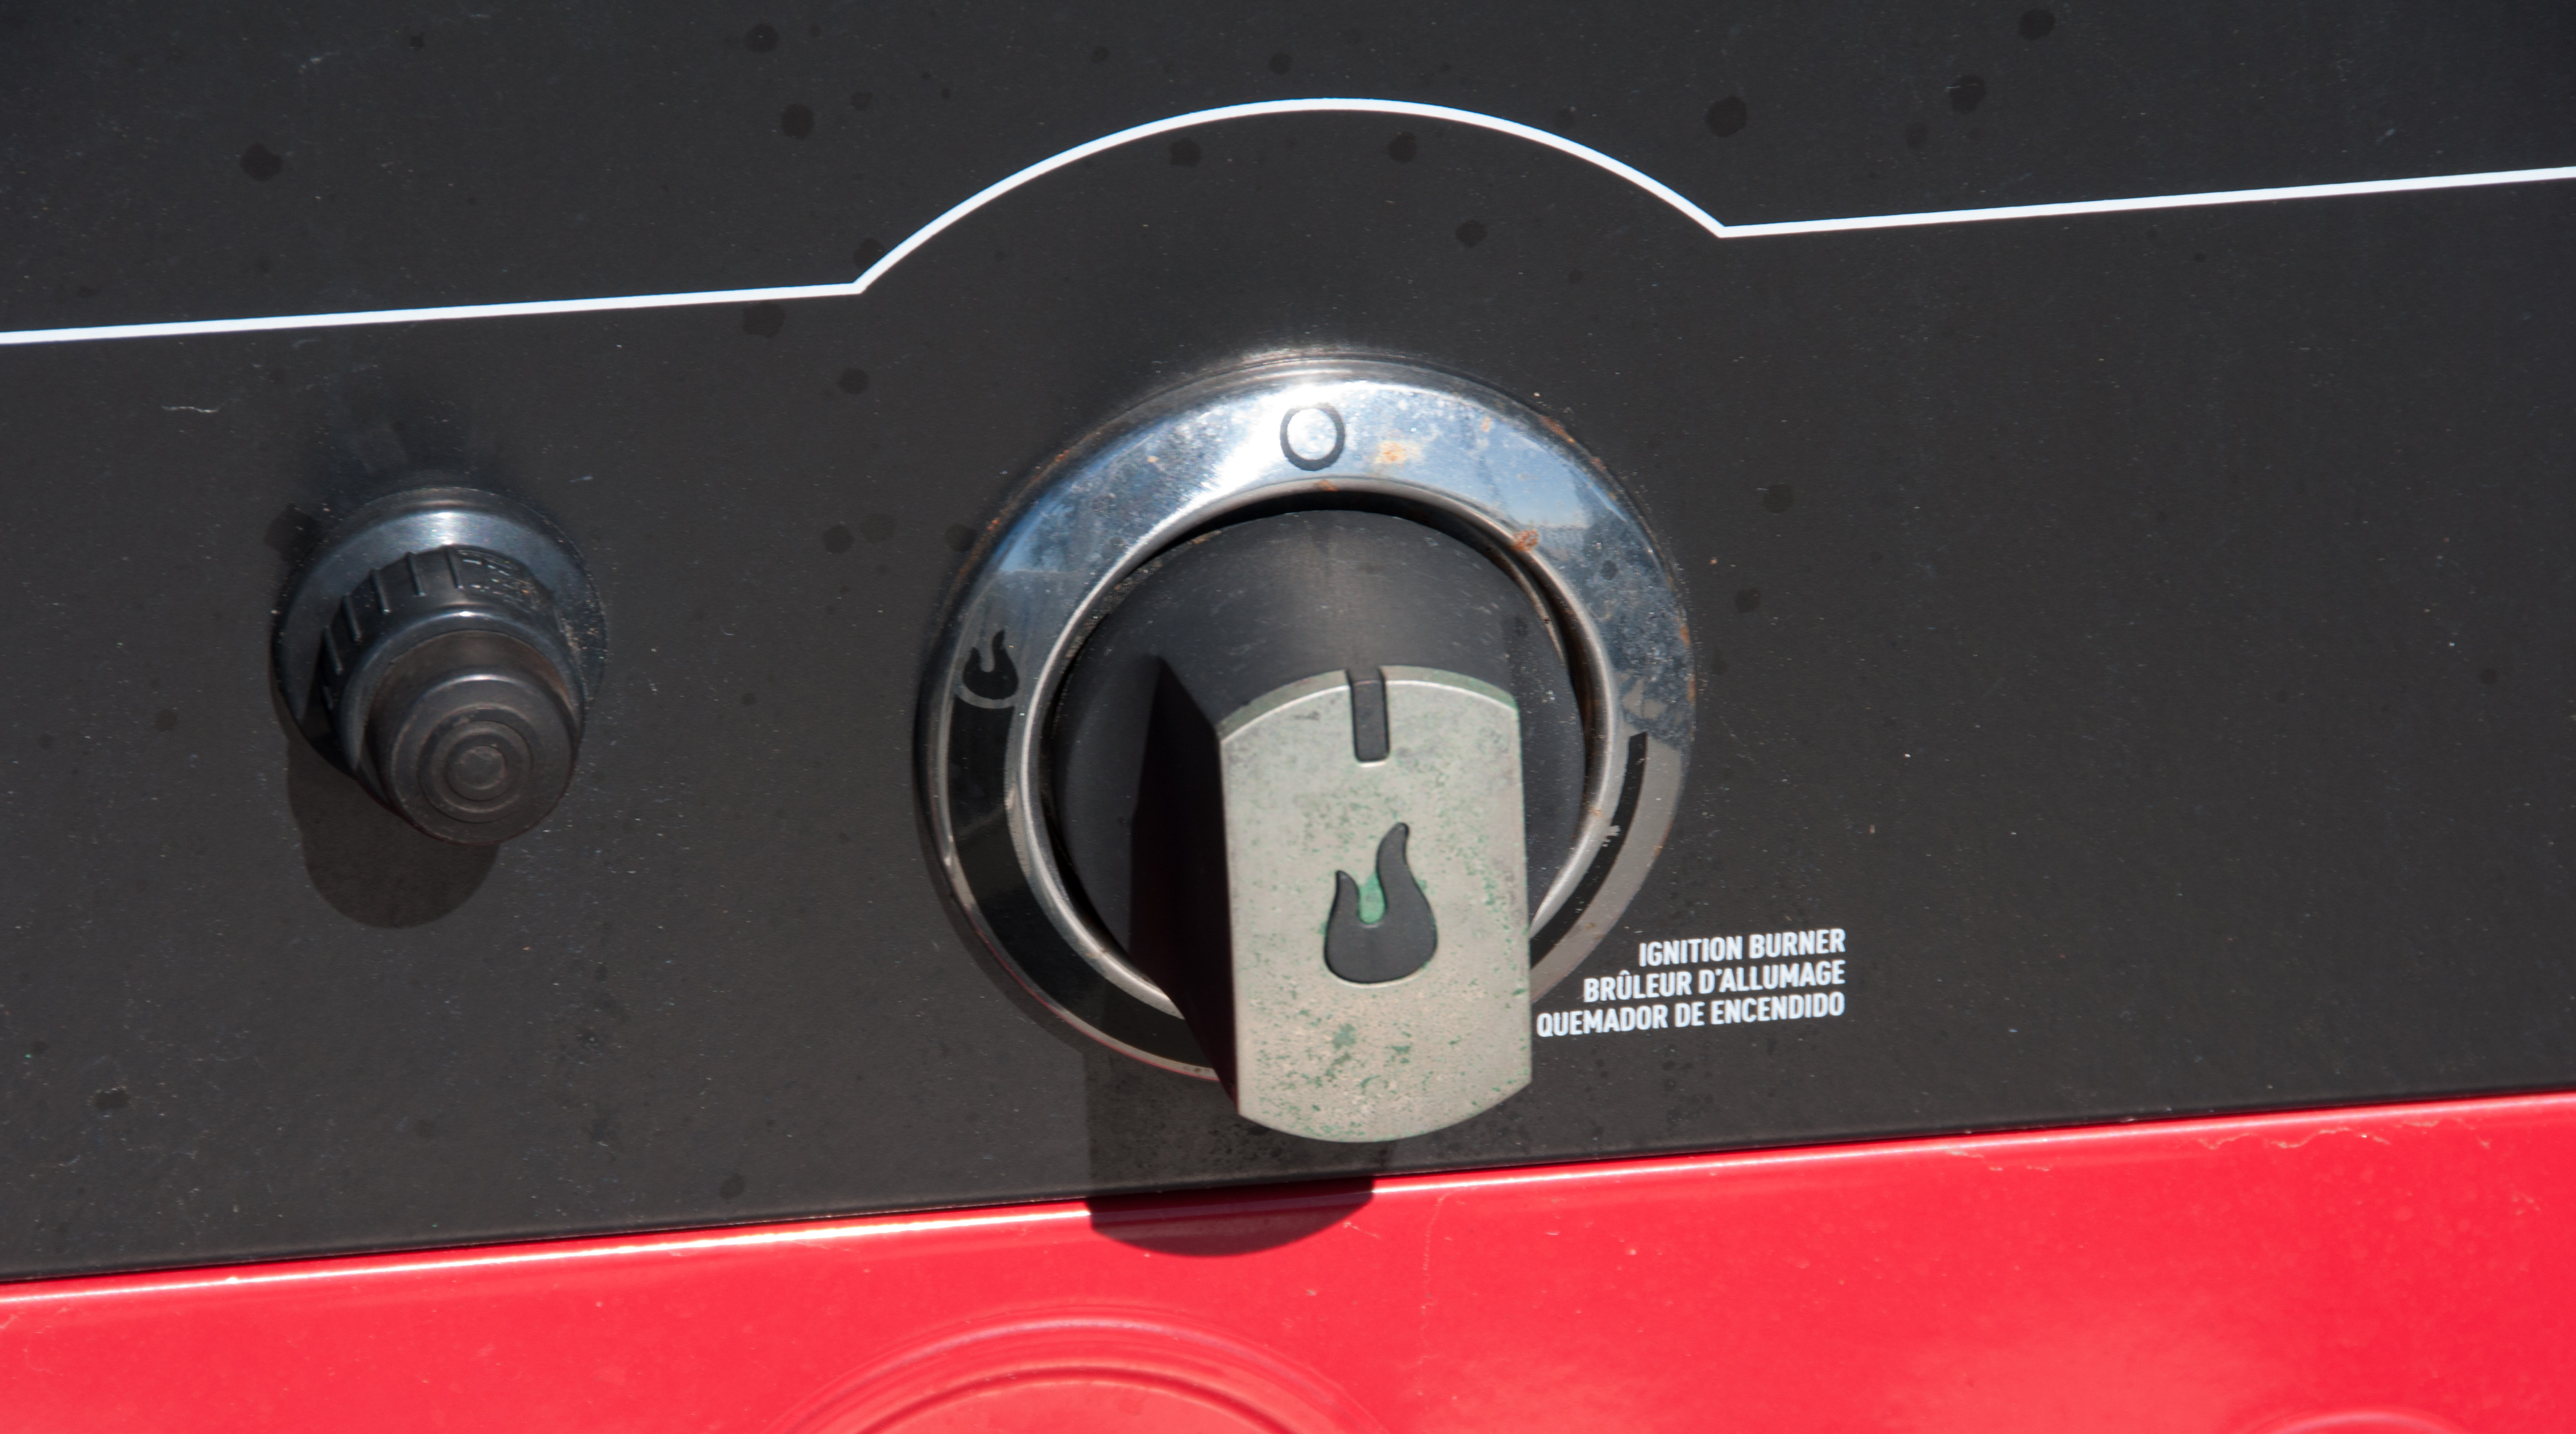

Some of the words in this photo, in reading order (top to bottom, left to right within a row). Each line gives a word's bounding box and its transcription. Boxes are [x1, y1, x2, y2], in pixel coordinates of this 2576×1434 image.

[1639, 935, 1743, 967] IGNITION
[1748, 928, 1846, 959] BURNER
[1583, 969, 1693, 1003] BRÛLEUR
[1698, 959, 1846, 995] D'ALLUMAGE
[1536, 1003, 1669, 1038] QUEMADOR
[1674, 1001, 1706, 1028] DE
[1710, 991, 1845, 1025] ENCENDIDO
